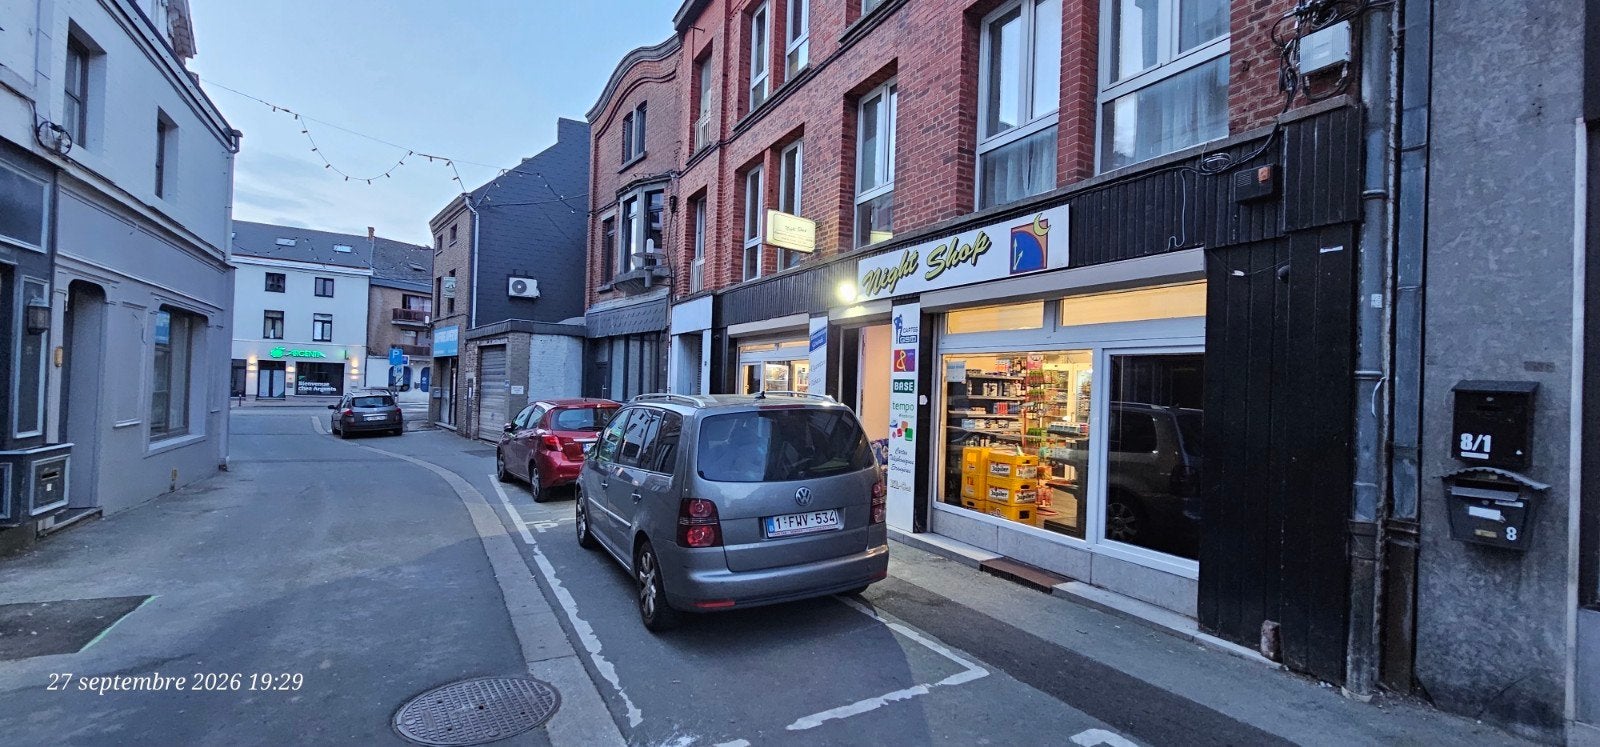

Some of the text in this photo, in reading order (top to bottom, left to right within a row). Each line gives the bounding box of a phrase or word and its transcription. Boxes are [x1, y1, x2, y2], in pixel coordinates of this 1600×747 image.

[862, 230, 992, 297] Night Shop
[393, 350, 400, 358] P
[894, 381, 914, 391] BASE
[892, 402, 914, 413] tempo
[1460, 433, 1492, 453] 8/1
[1506, 526, 1517, 541] 8
